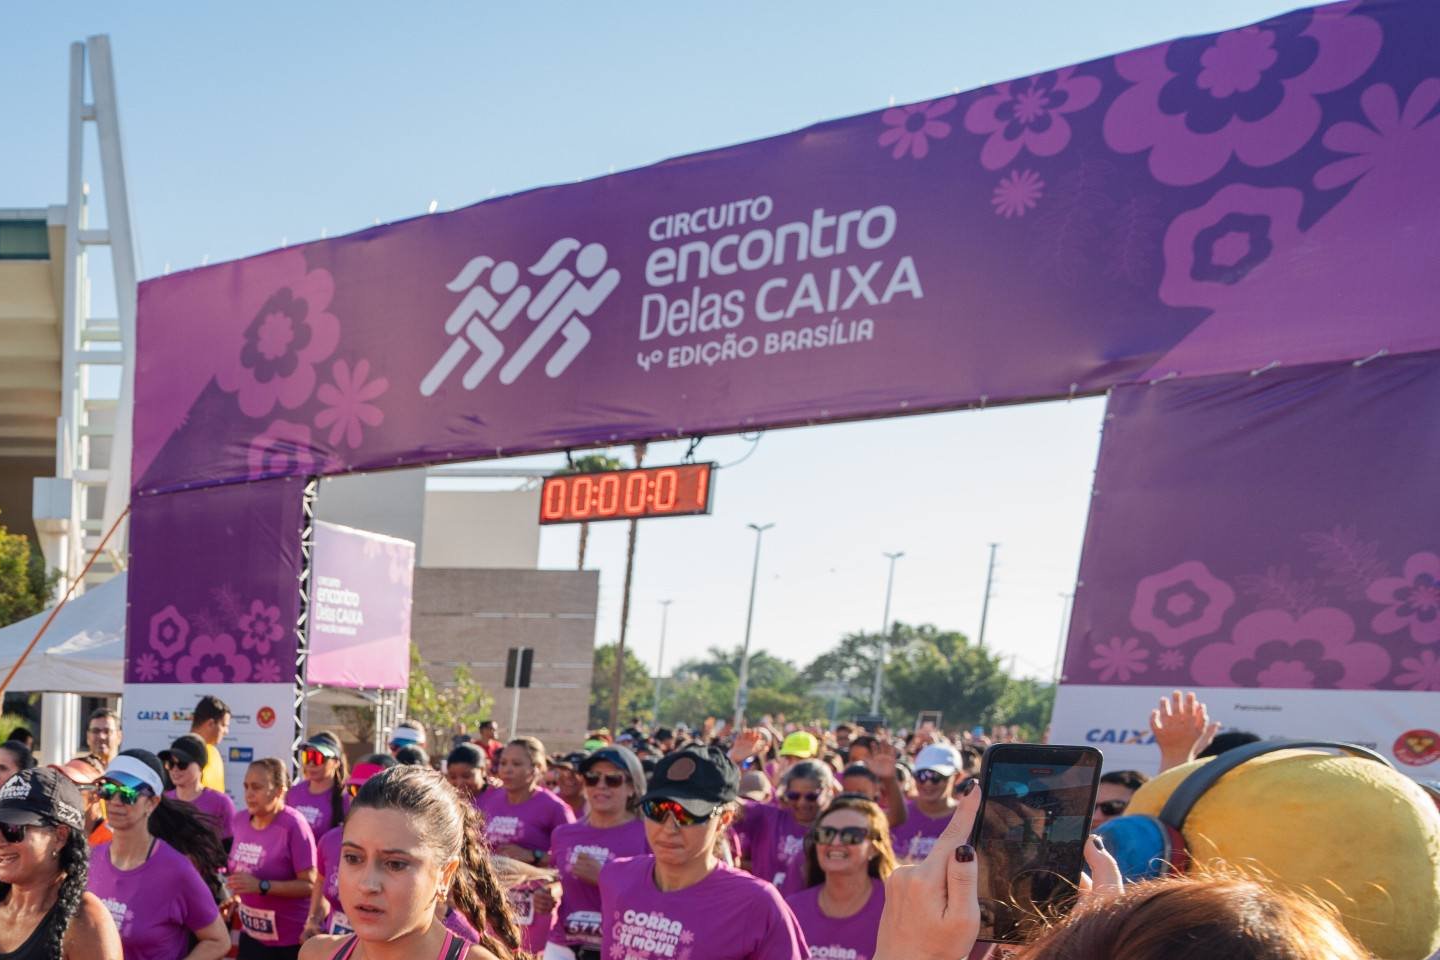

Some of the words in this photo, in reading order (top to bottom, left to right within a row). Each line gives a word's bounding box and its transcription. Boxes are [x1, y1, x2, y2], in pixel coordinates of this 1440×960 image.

[648, 195, 773, 242] CIRCUITO
[644, 205, 897, 287] encontro
[639, 286, 745, 341] Delas
[755, 256, 924, 322] CAIXA
[667, 333, 759, 368] EDIÇÃO
[763, 316, 875, 354] BRASÍLIA
[623, 909, 683, 936] CORRA
